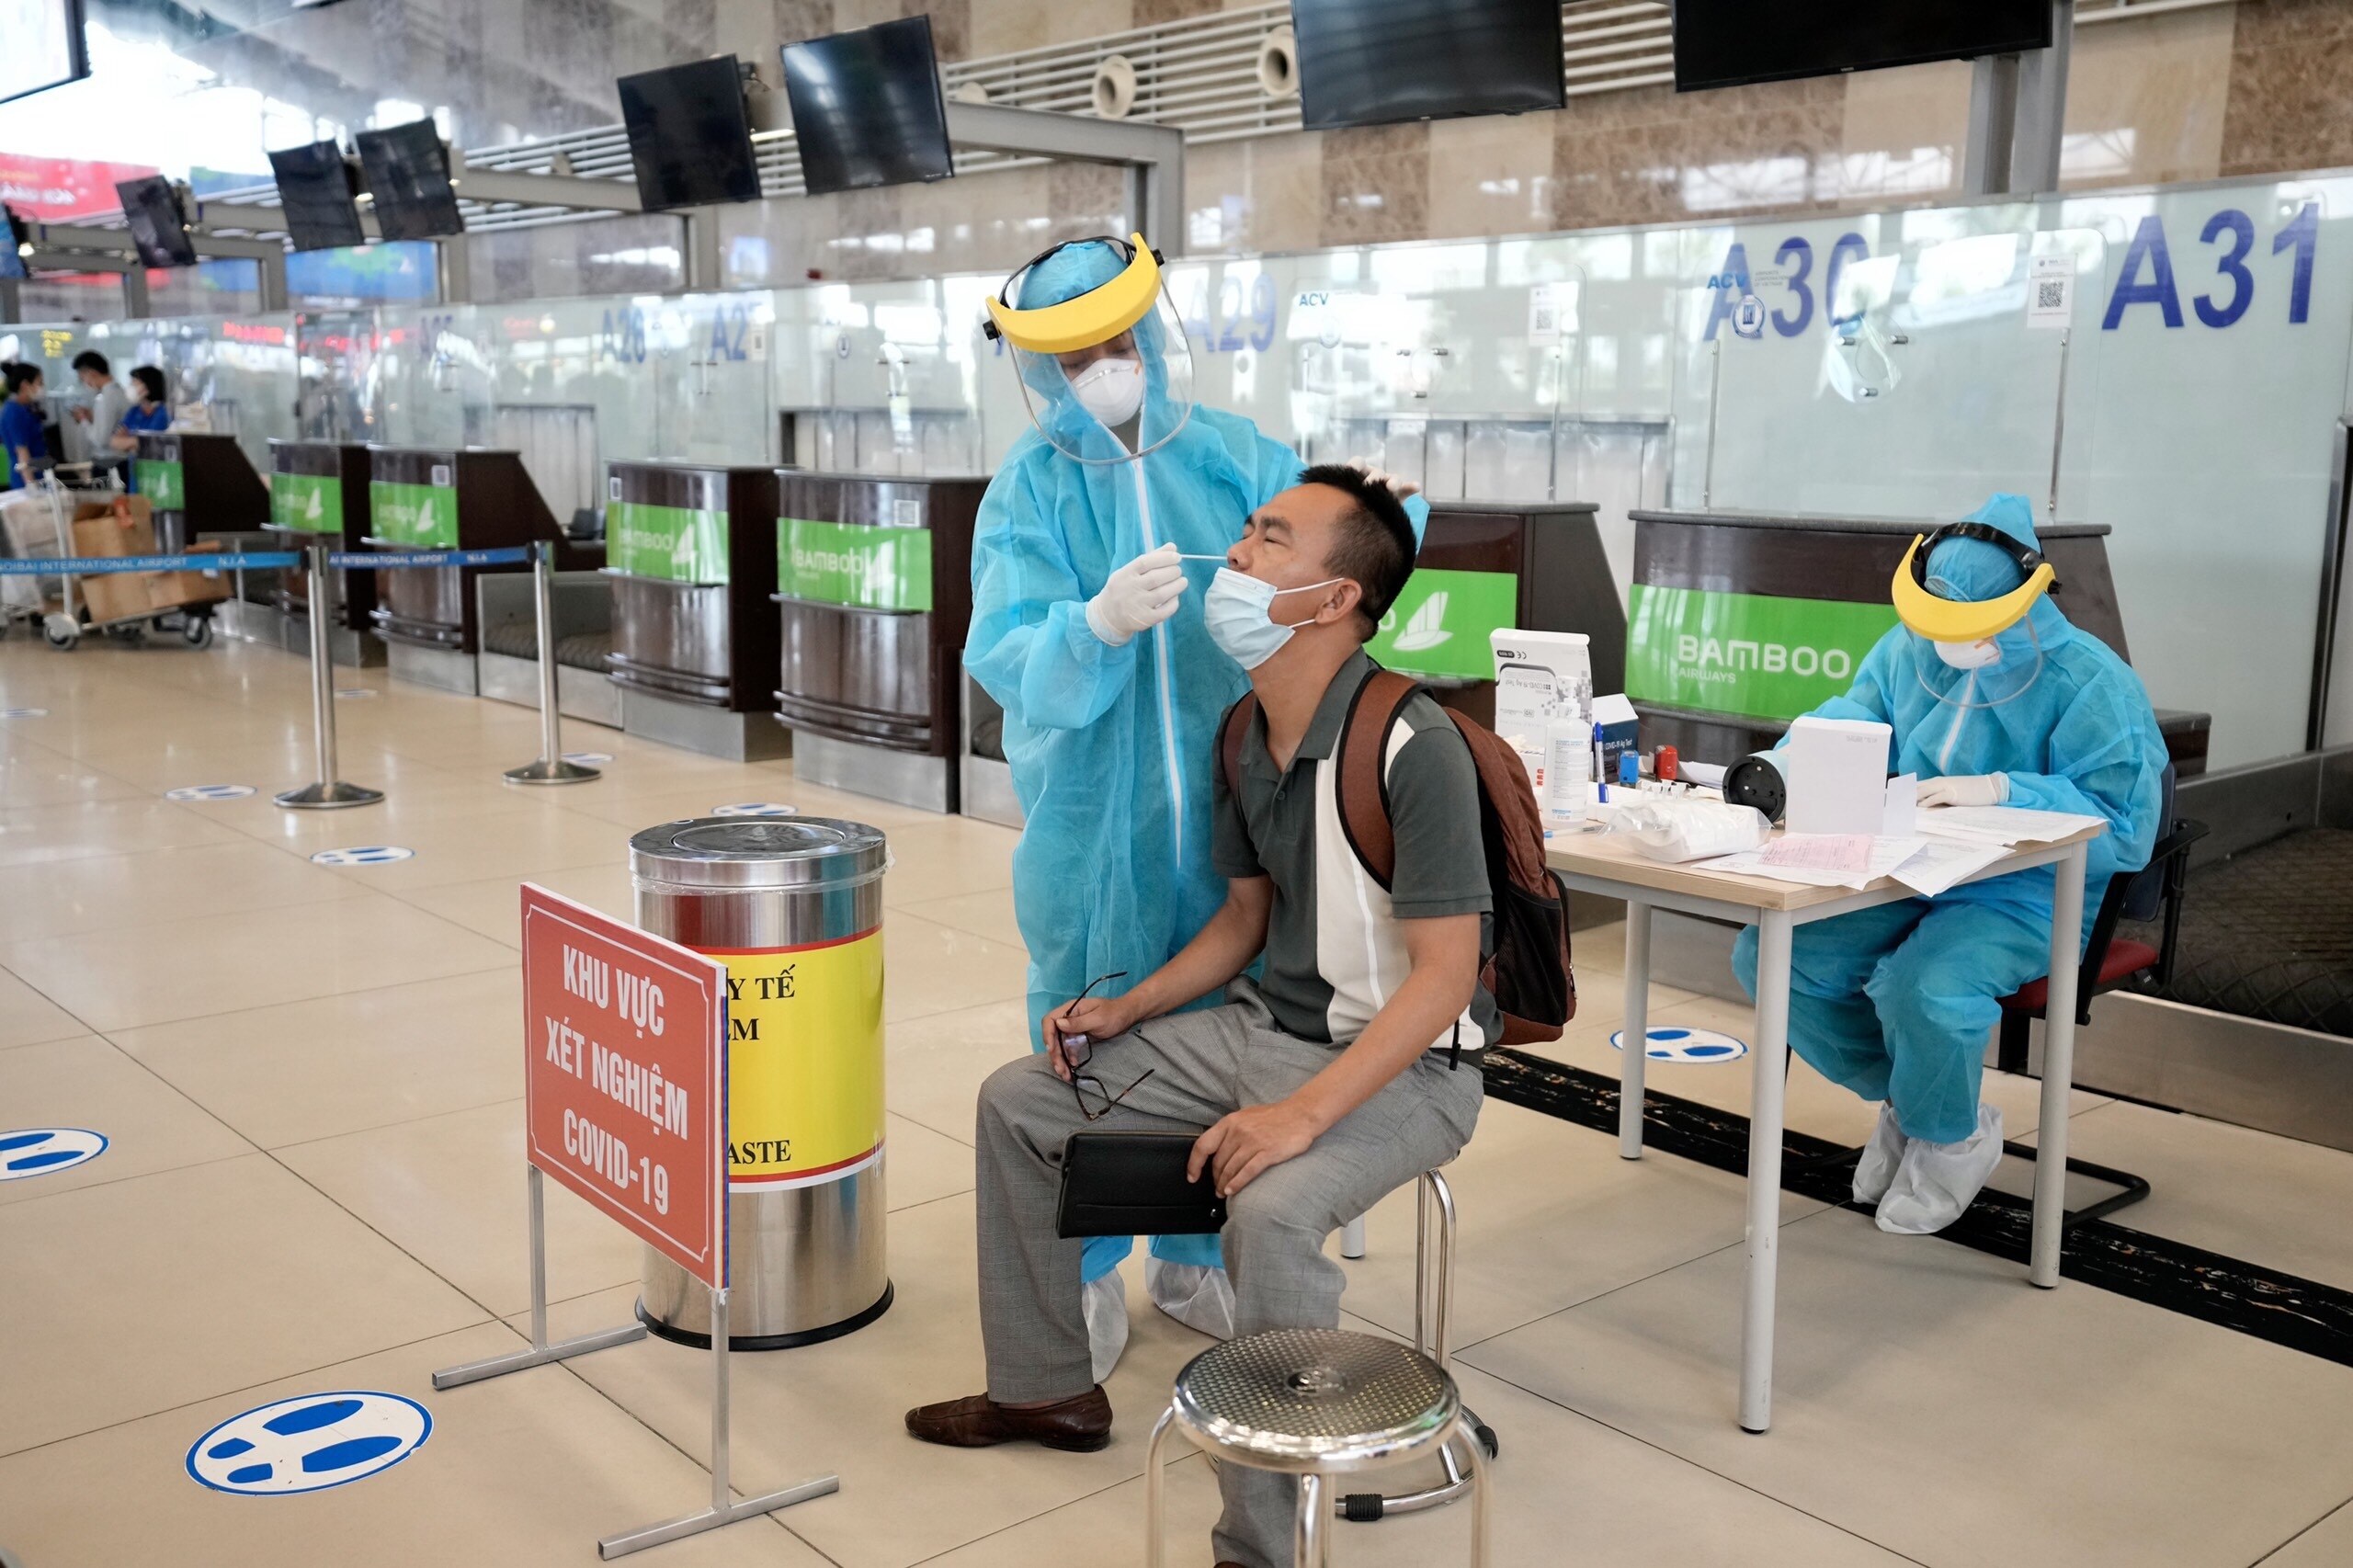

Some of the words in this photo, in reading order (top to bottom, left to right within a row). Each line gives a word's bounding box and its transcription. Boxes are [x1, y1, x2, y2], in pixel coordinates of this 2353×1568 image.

[1707, 273, 1746, 289] ACV
[2102, 202, 2319, 330] A31
[1182, 273, 1278, 352] A29
[1299, 293, 1329, 306] ACV
[40, 559, 136, 570] INTERNATIONAL
[137, 557, 188, 568] AIRPORT
[341, 554, 410, 564] INTERNATIONAL
[413, 553, 448, 563] AIRPORT
[1678, 634, 1850, 679] BAMBOO
[1678, 667, 1736, 684] AIRWAYS
[563, 944, 608, 1009] KHU
[616, 968, 665, 1039] VỰC
[756, 964, 796, 1000] TẾ
[545, 1016, 585, 1079] XÉT
[592, 1040, 688, 1141] NGHIỆM
[563, 1108, 669, 1215] COVID-19
[727, 1140, 791, 1165] ASTE
